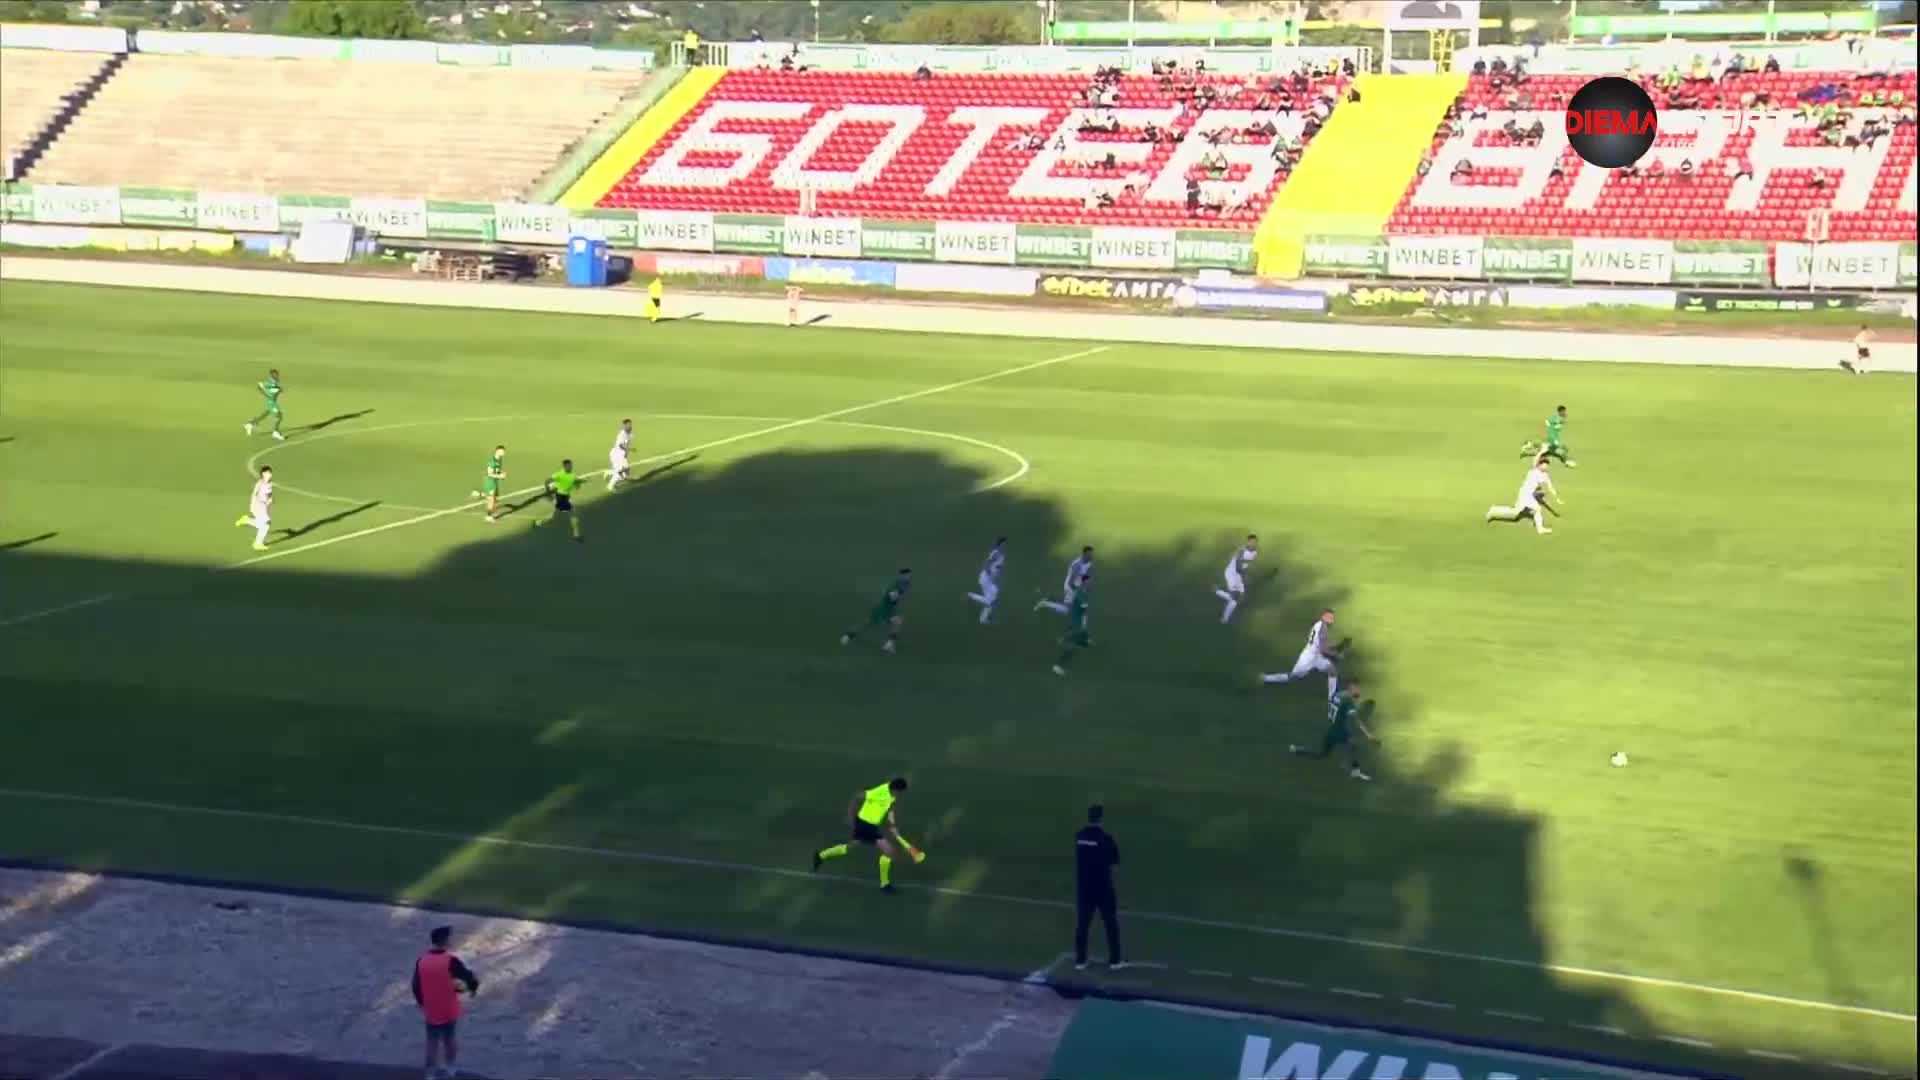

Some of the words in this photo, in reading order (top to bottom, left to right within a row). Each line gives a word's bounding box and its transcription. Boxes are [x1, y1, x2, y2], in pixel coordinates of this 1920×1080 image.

[643, 223, 708, 240] WINBET
[789, 229, 856, 246] WINBET
[941, 235, 1009, 251] WINBET
[1097, 240, 1170, 257] WINBET
[1396, 248, 1476, 266] WINBET
[1580, 252, 1664, 270] WINBET
[1796, 256, 1889, 273] WINBET
